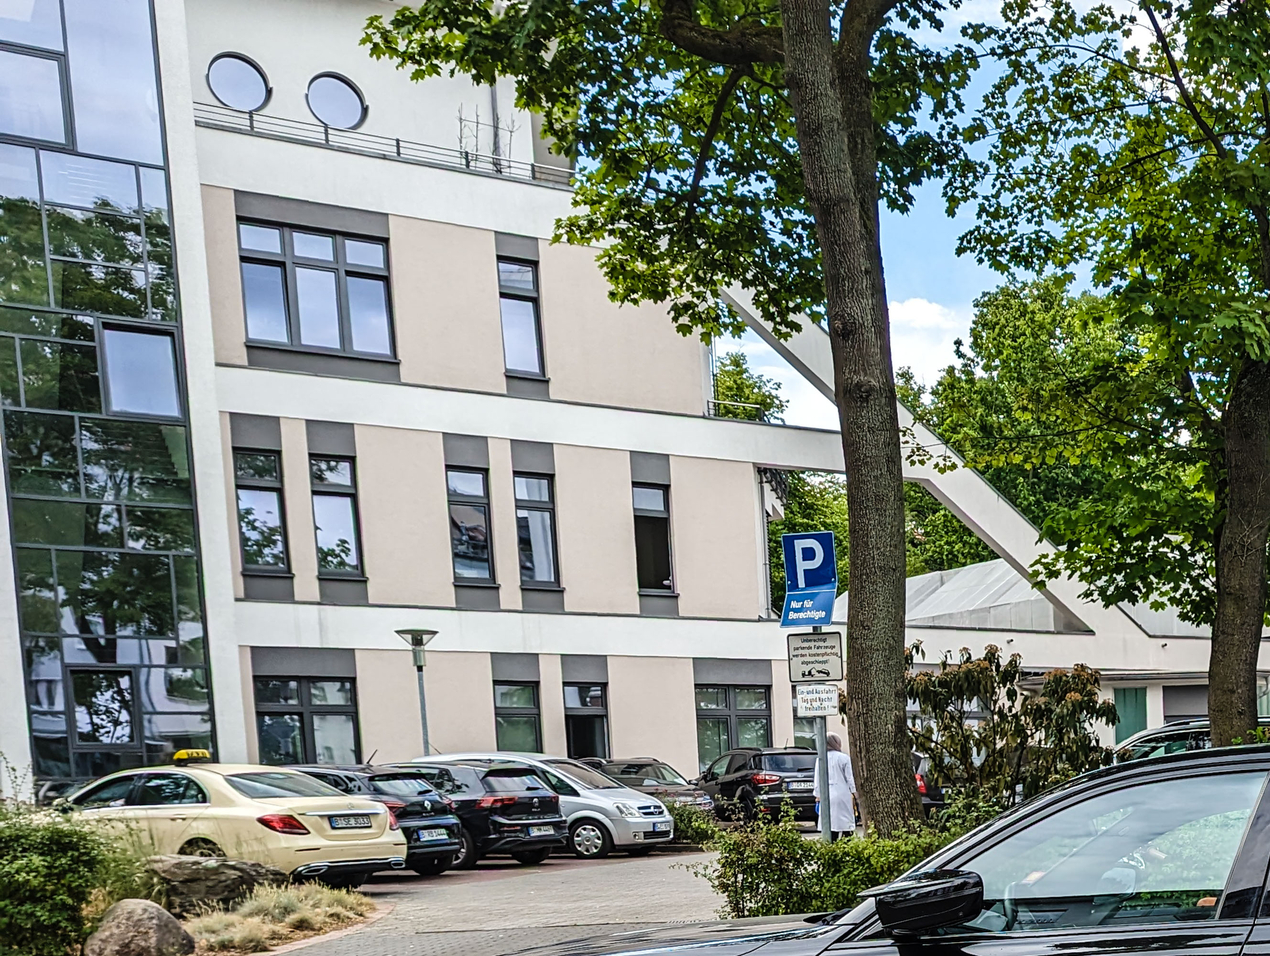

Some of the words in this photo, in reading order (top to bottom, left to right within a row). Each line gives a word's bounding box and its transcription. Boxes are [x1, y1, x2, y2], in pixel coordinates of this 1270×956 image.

[794, 539, 824, 588] P
[790, 600, 803, 608] Nur
[803, 599, 814, 607] für
[788, 610, 826, 619] Berechtigte
